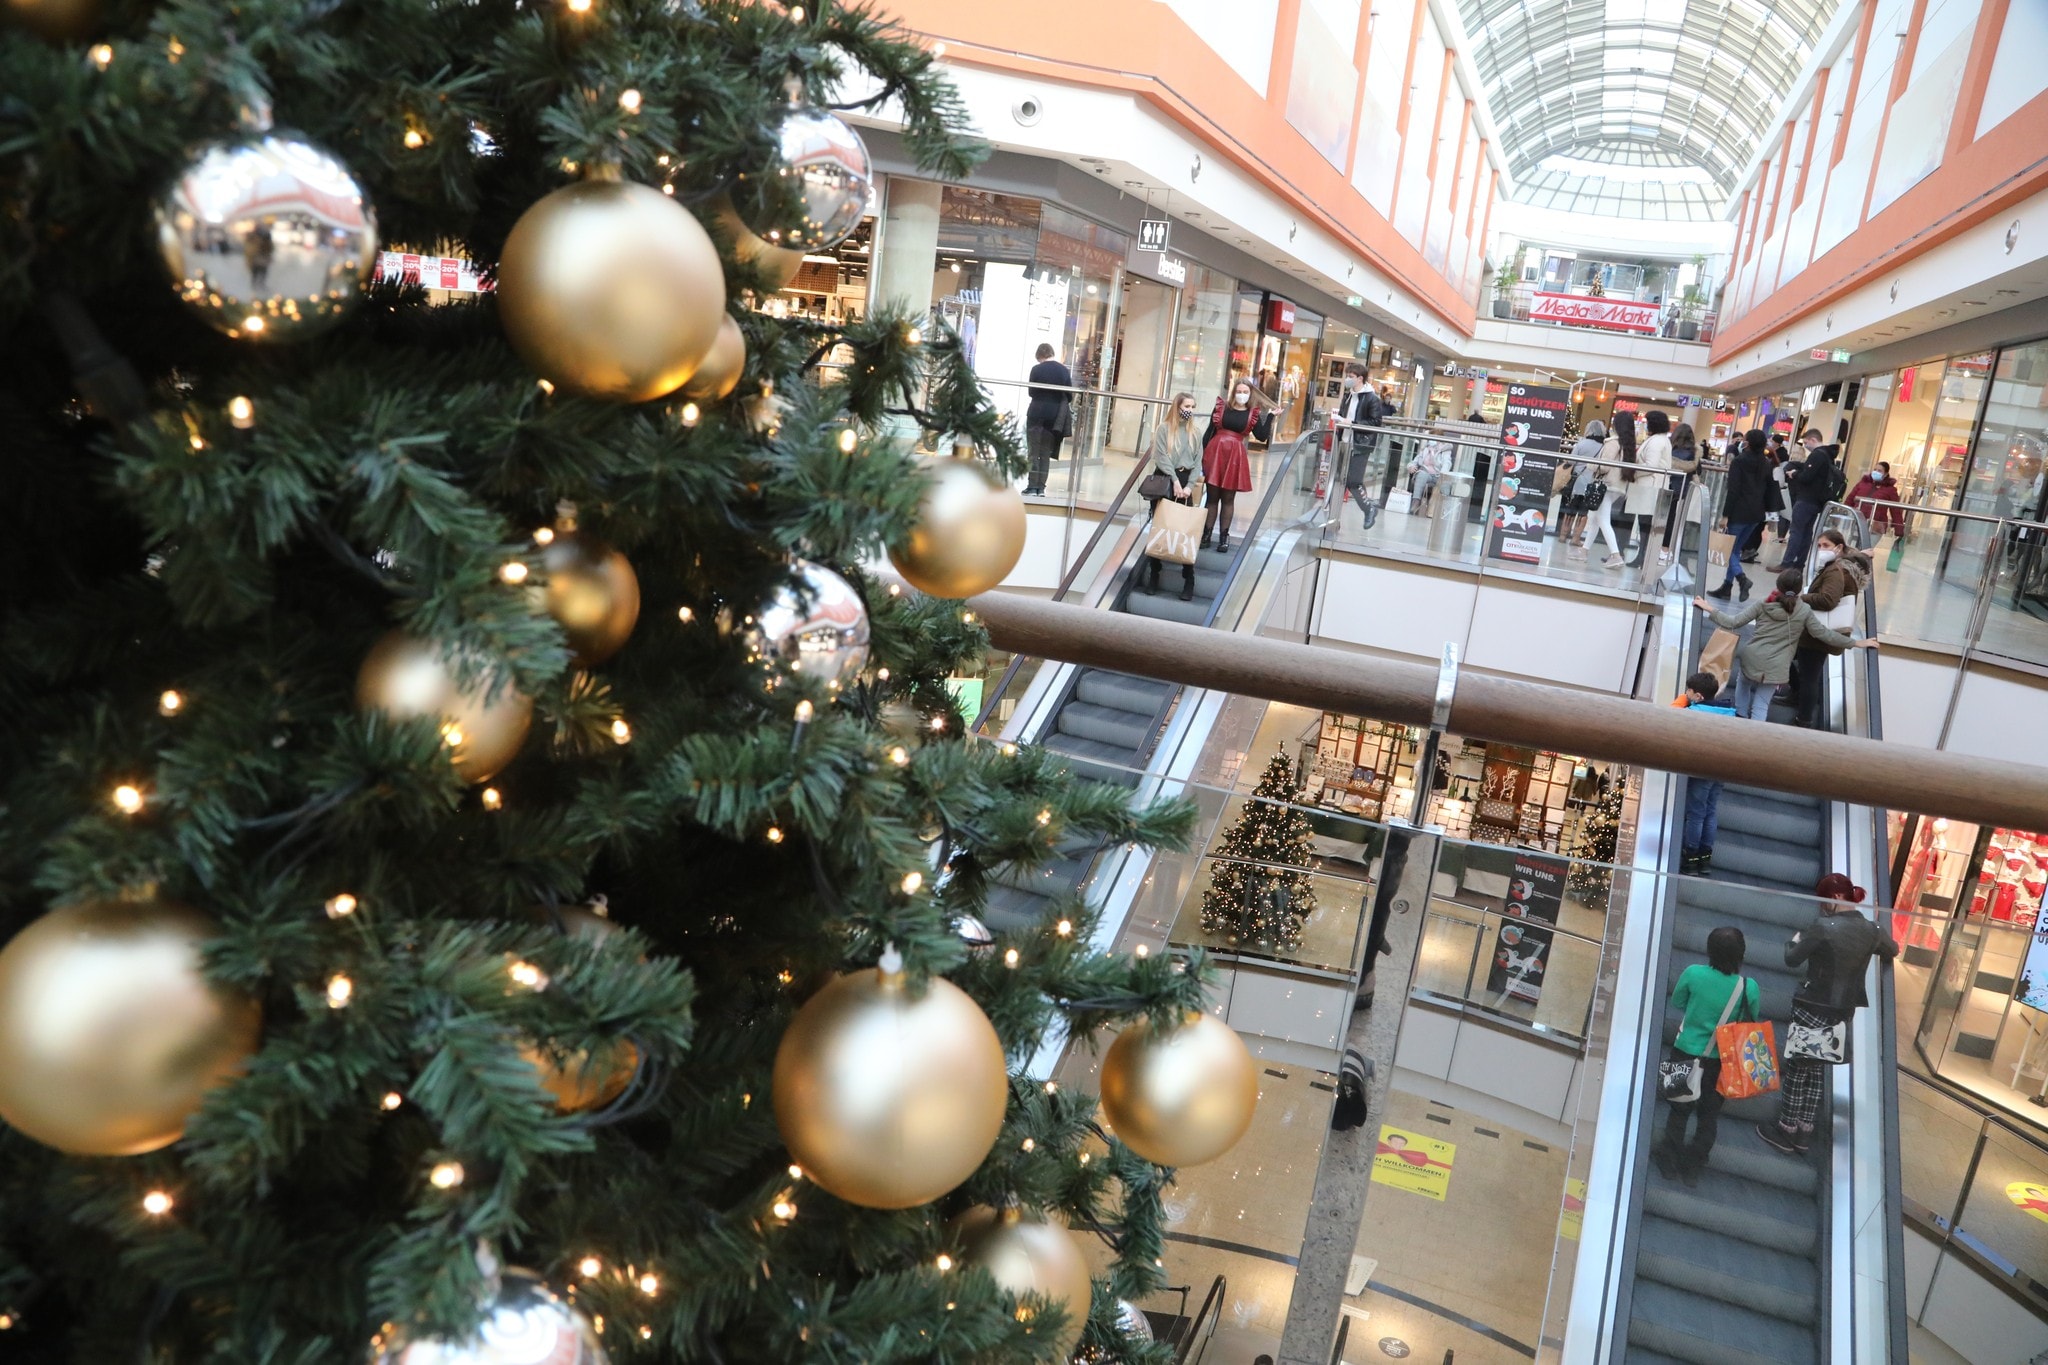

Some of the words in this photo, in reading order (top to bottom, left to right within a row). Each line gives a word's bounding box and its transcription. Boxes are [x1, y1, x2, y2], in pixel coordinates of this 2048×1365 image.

[1510, 386, 1526, 396] SO
[1509, 395, 1566, 411] SCHÜTZEN
[1507, 405, 1528, 416] WIR
[1530, 408, 1555, 420] UNS.
[1515, 864, 1533, 876] WIR
[1534, 870, 1556, 883] UNS.
[1384, 1159, 1442, 1176] WILLKOMMEN
